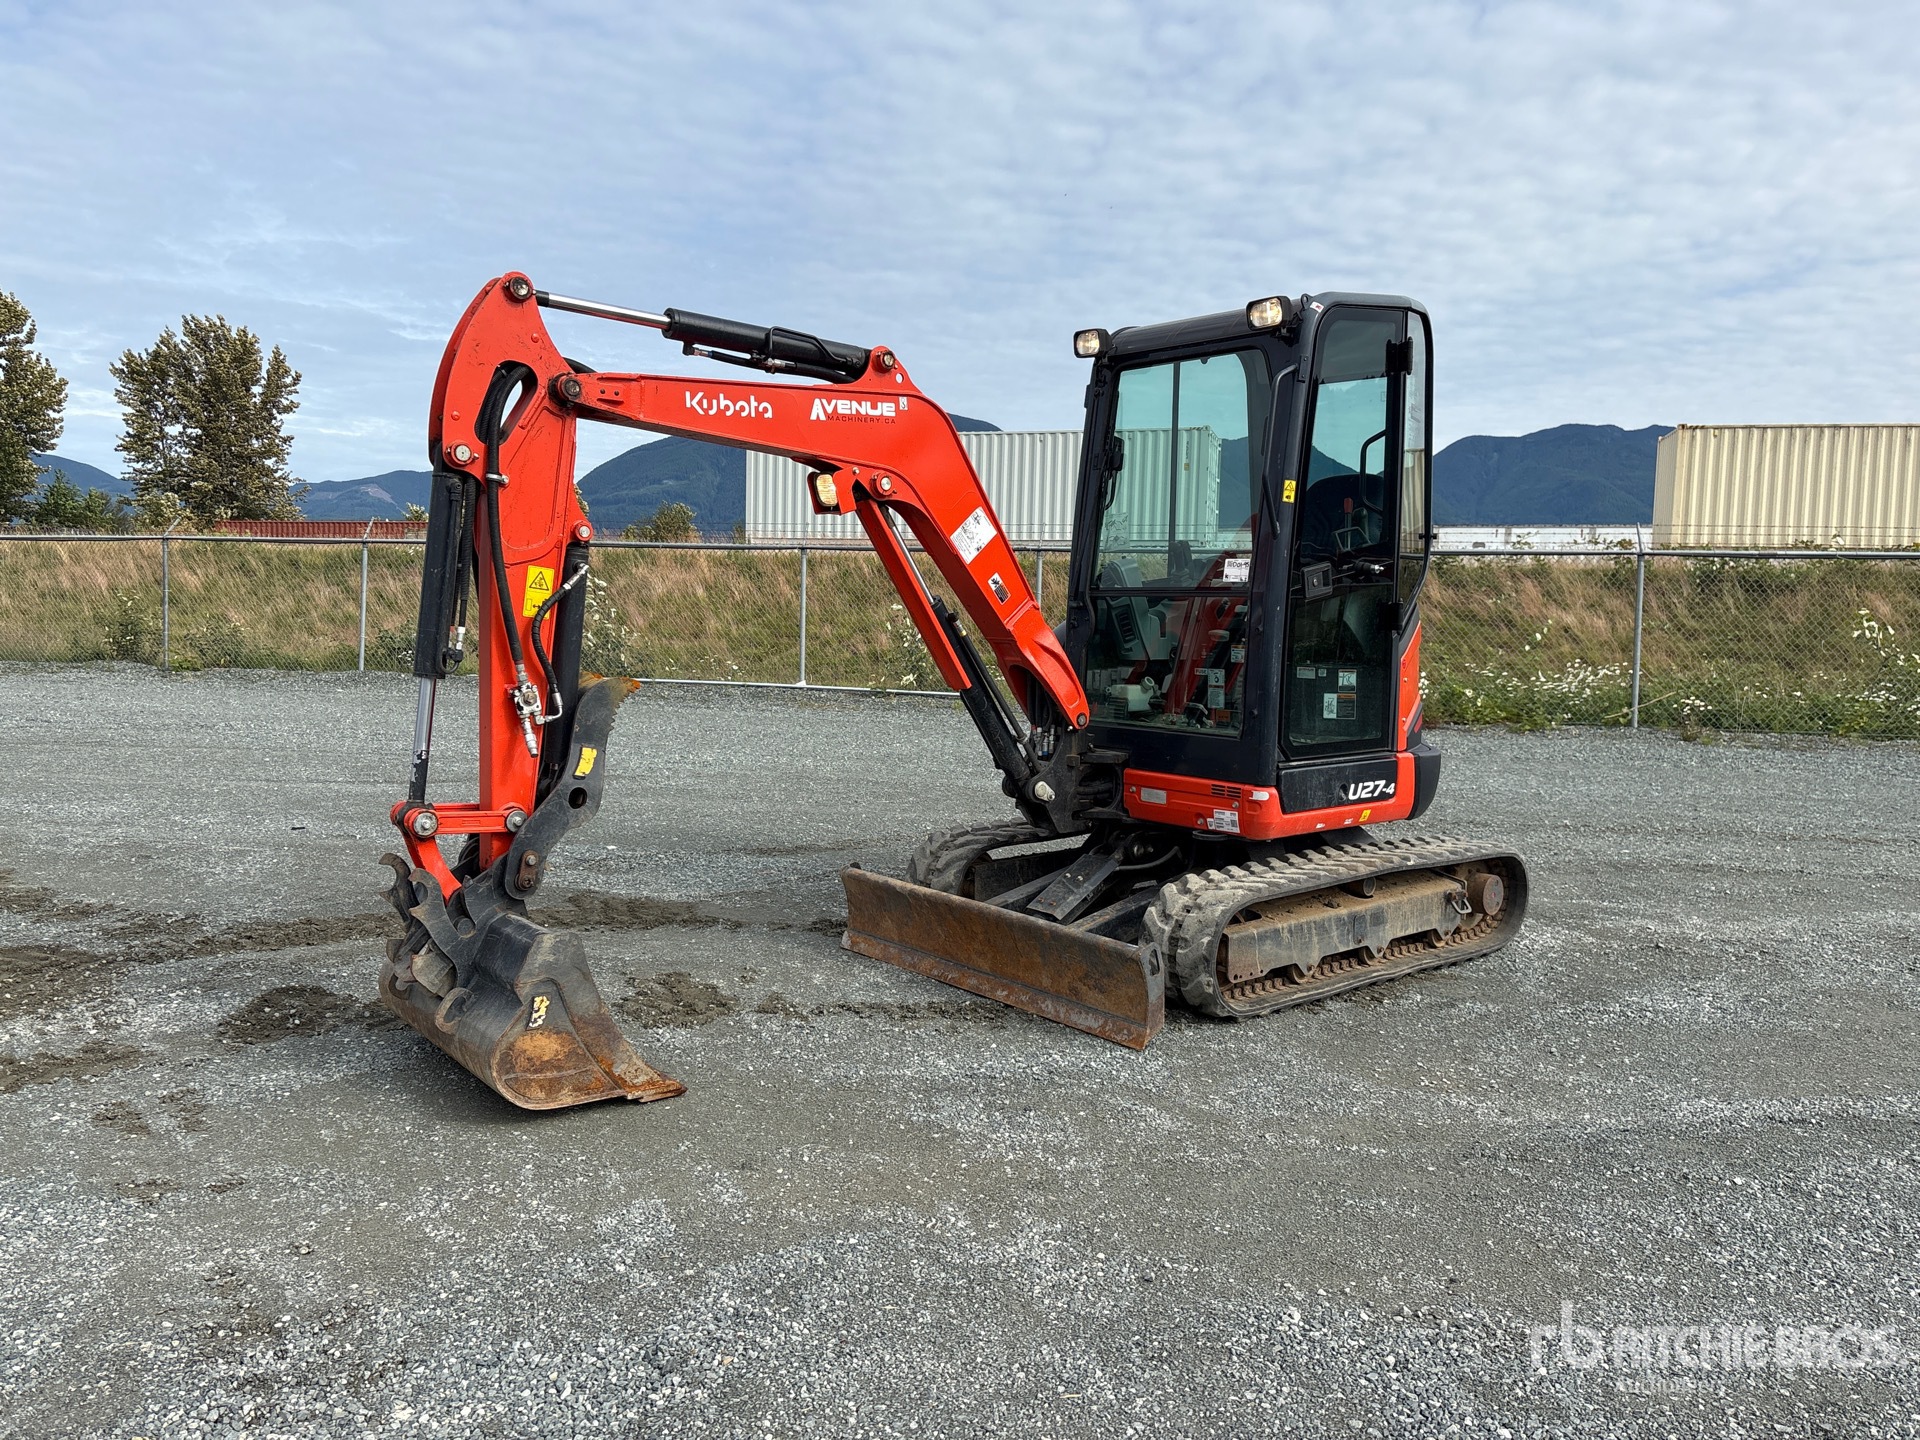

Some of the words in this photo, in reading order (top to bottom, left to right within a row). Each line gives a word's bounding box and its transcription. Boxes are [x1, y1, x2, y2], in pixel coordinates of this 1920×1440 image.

[685, 391, 773, 418] Kubota
[810, 398, 896, 421] AVENUE
[827, 415, 896, 424] MACHINERY.CA
[1348, 780, 1396, 800] U27-4
